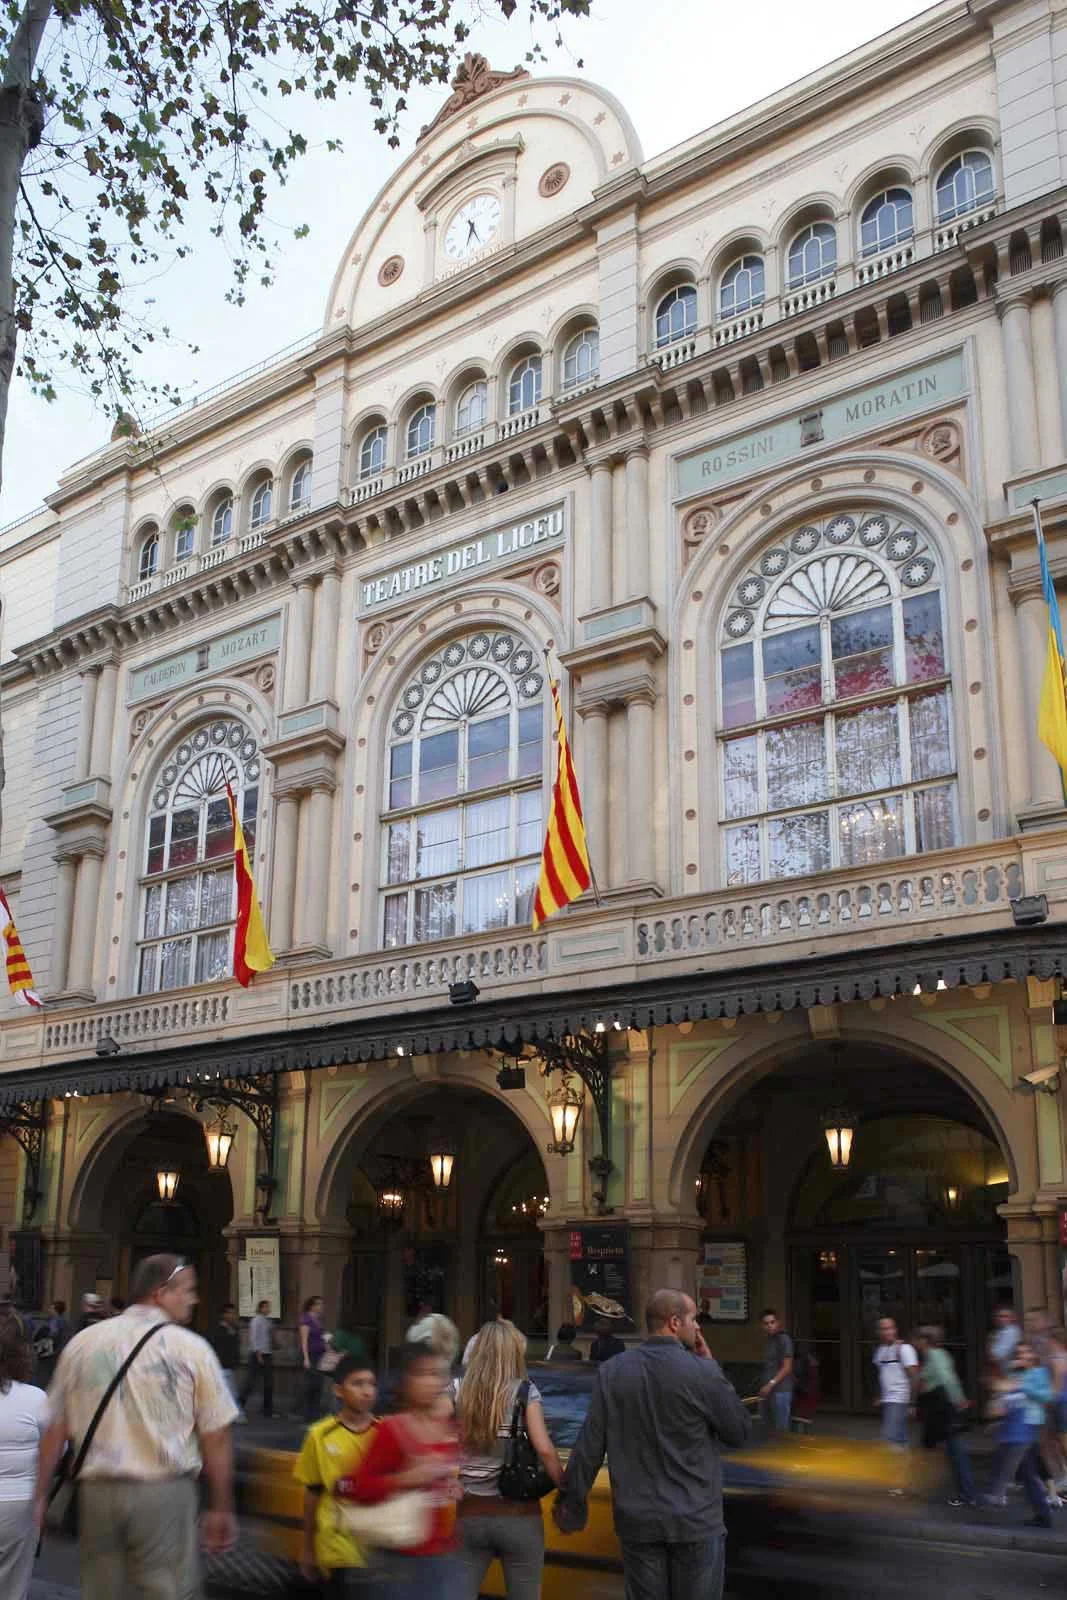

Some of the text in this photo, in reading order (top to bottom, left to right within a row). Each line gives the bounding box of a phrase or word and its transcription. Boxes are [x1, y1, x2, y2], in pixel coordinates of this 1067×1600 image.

[701, 374, 938, 478] ROSSINI MORATIN
[363, 509, 564, 608] TEATRE DEL LICEU
[143, 628, 268, 688] CALDERON MOZART
